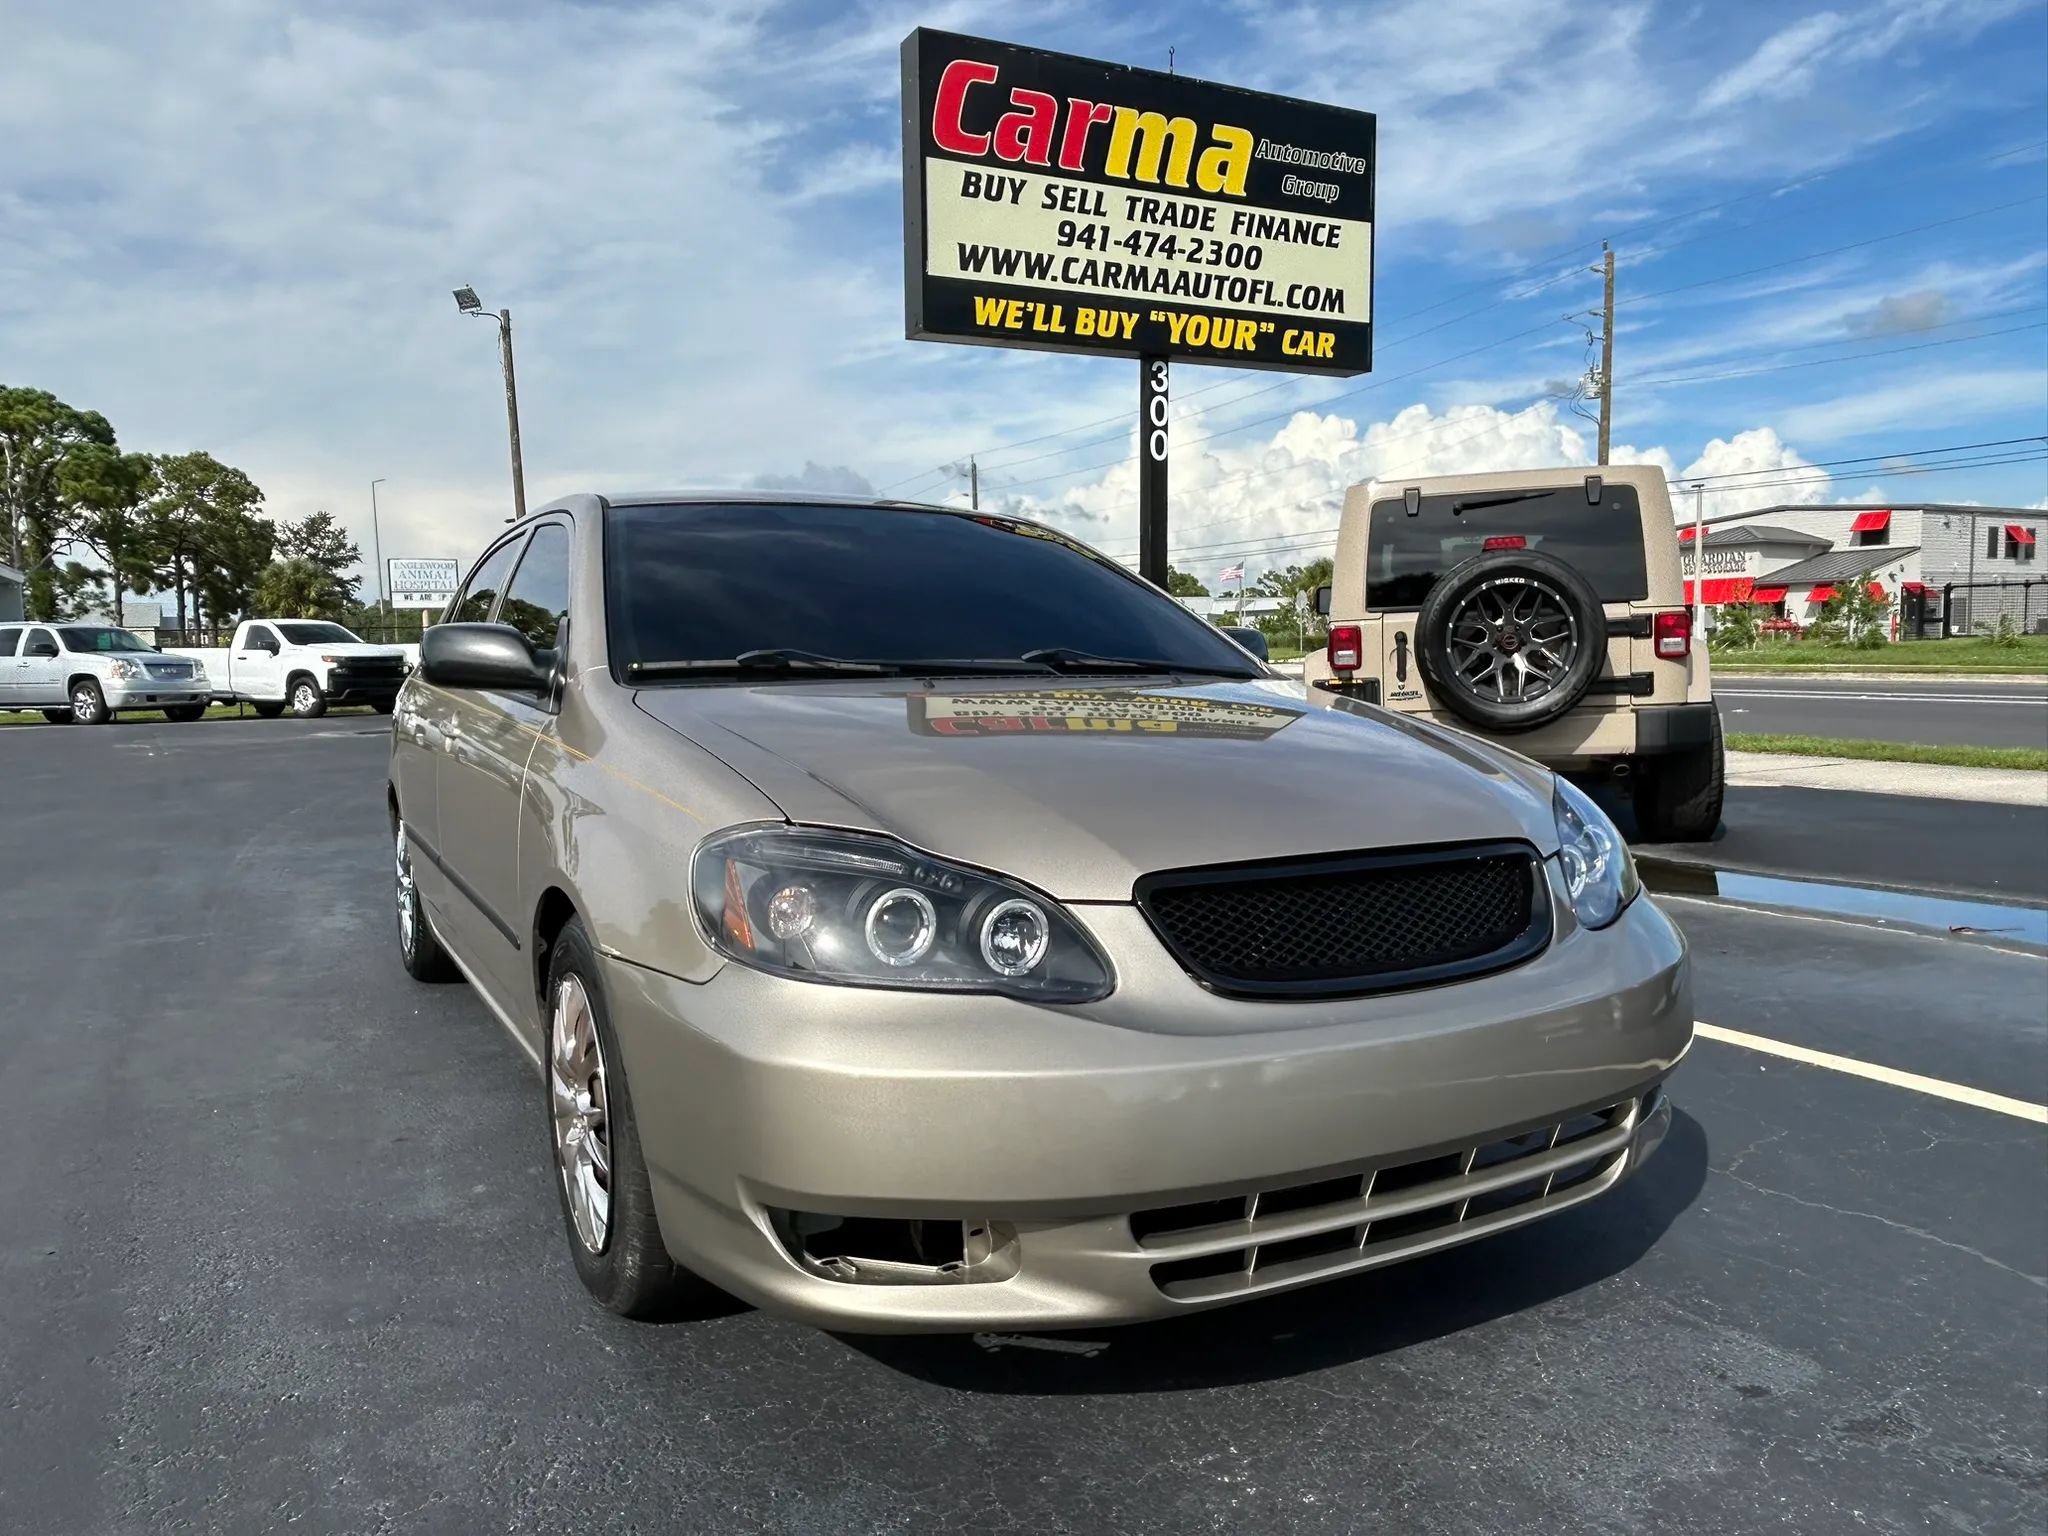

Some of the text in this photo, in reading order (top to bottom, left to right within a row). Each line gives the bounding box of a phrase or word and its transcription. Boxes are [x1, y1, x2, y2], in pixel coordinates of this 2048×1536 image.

[932, 59, 1255, 197] Carma
[1255, 138, 1366, 174] Automotive
[961, 170, 1342, 249] BUY SELL TRADE FINANCE
[1281, 174, 1340, 204] Group
[1057, 220, 1263, 272] 941-474-2300
[957, 243, 1345, 315] WWW.CARMAAUTOFL.COM
[973, 296, 1336, 359] WE'LL BUY "YOUR" CAR
[1150, 360, 1168, 461] 300
[393, 580, 453, 589] HOSPITAL
[394, 561, 455, 570] ENGLEWOOD
[398, 570, 452, 579] ANIMAL
